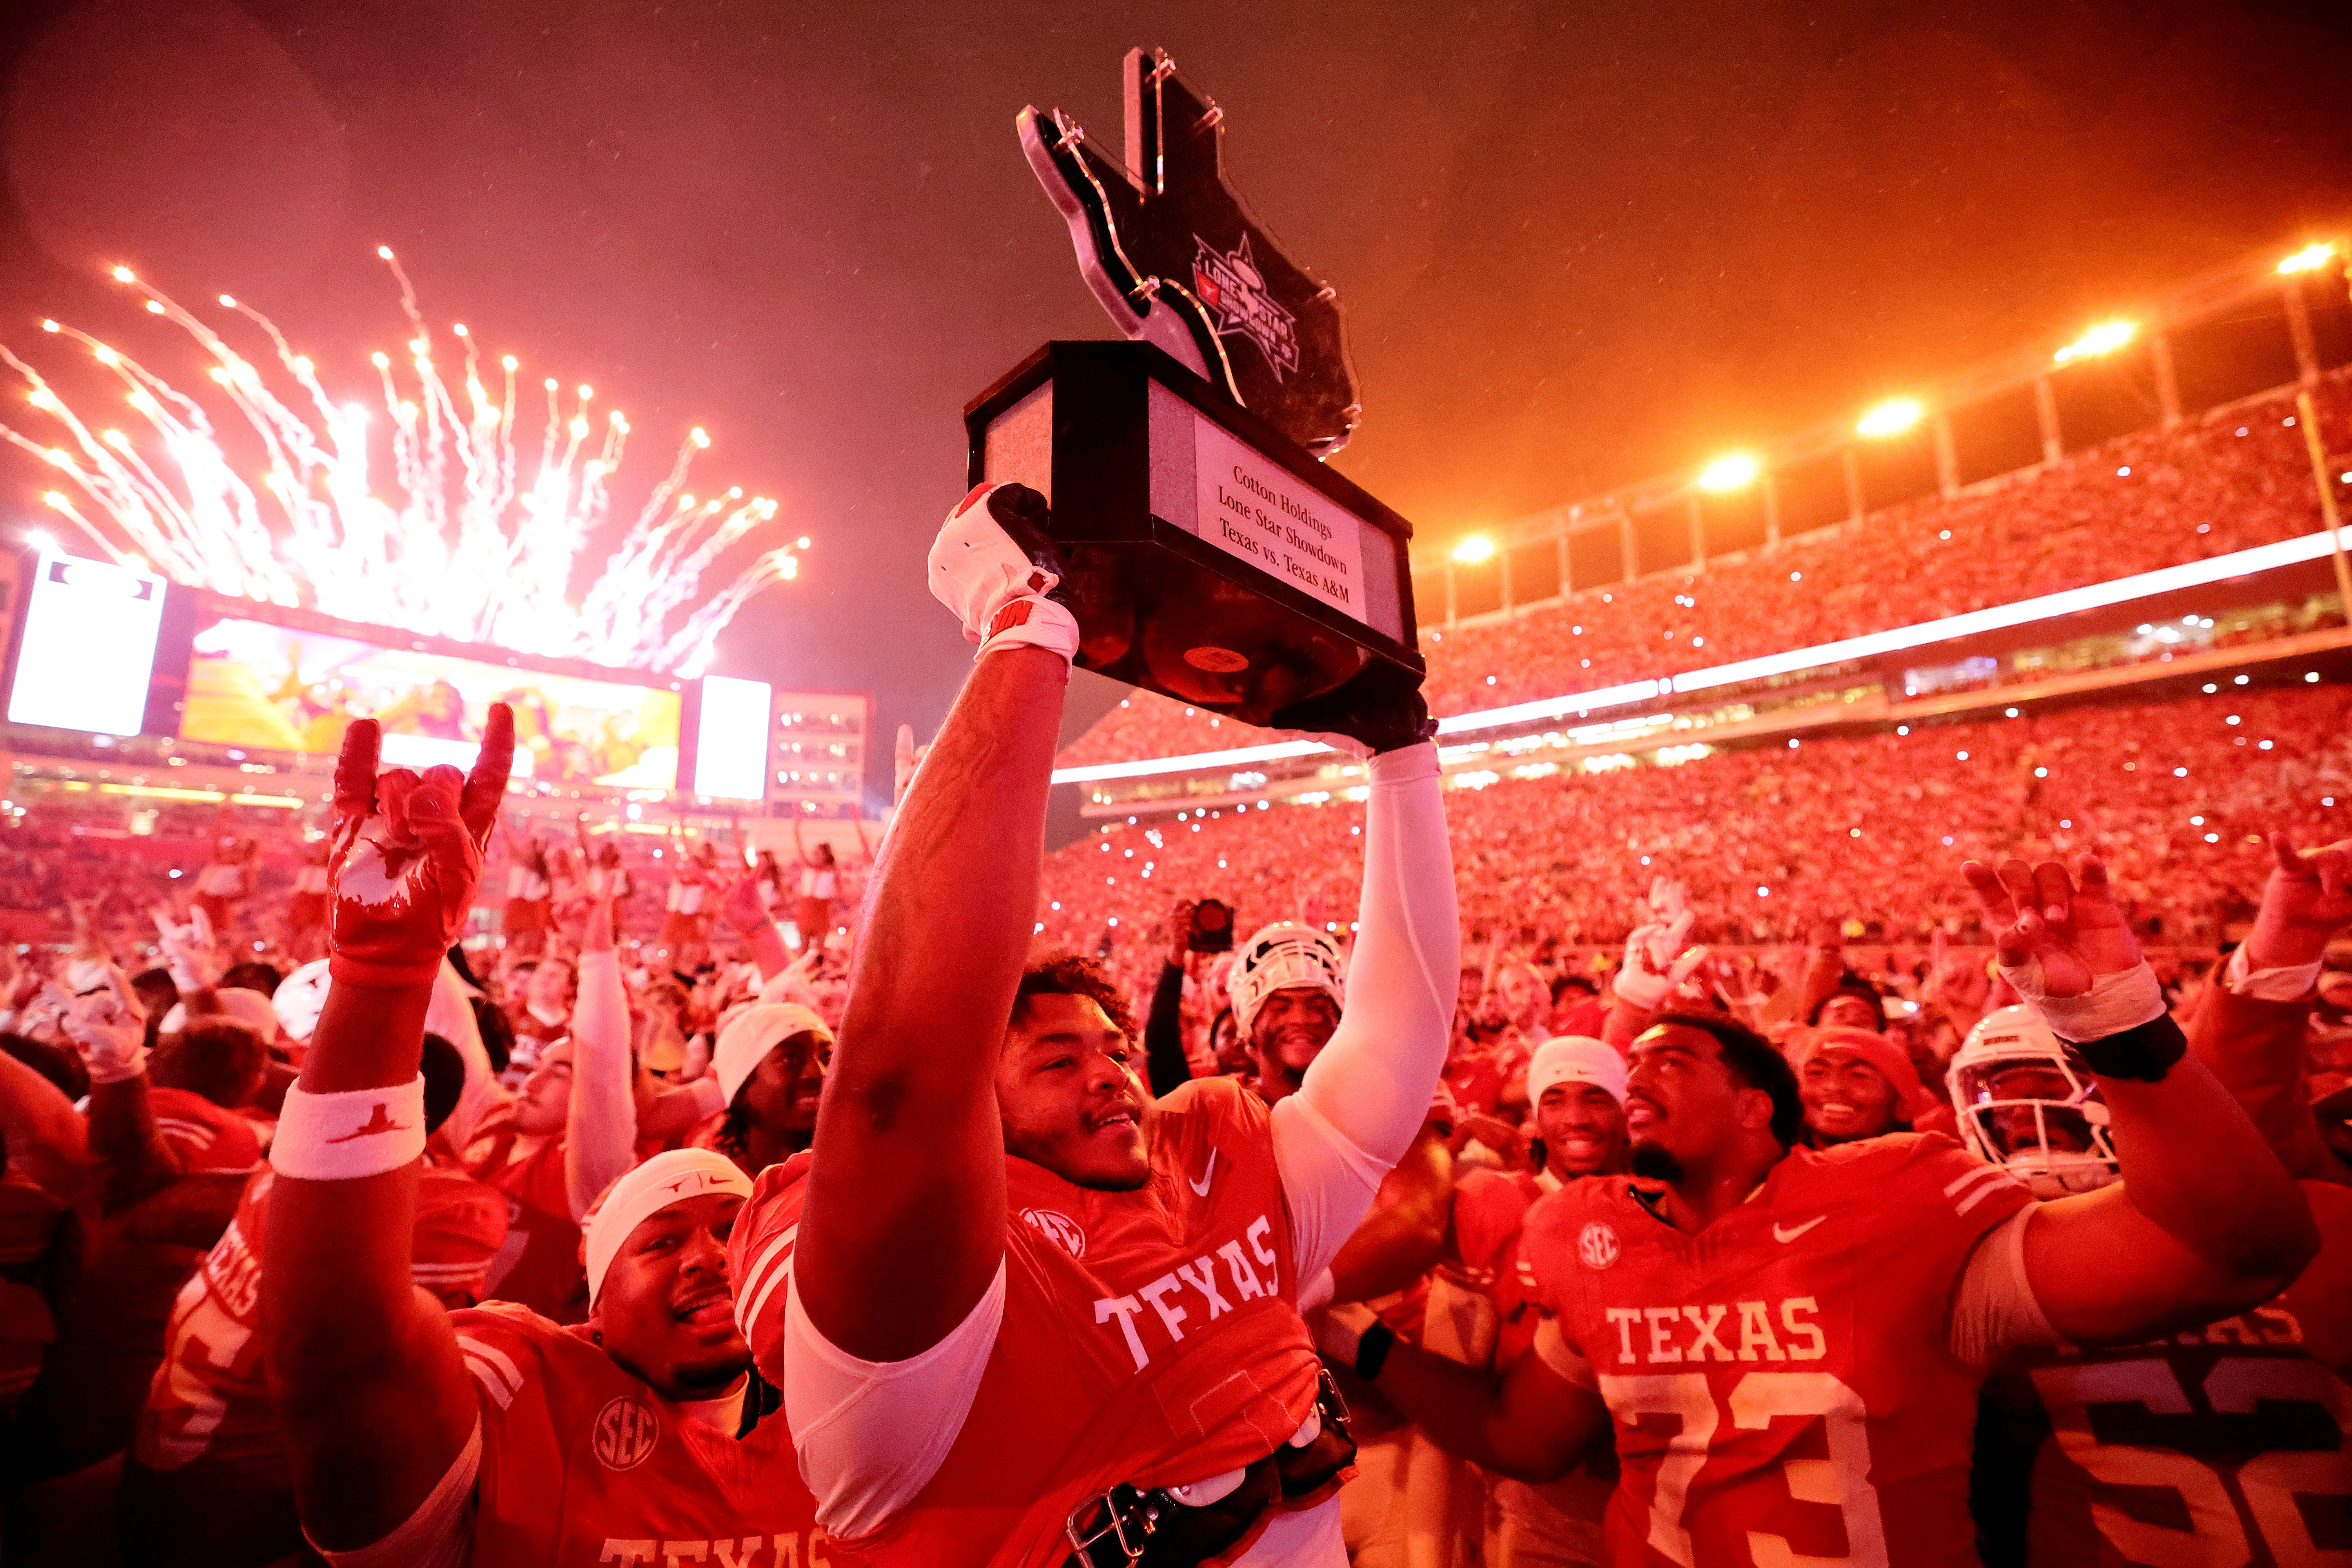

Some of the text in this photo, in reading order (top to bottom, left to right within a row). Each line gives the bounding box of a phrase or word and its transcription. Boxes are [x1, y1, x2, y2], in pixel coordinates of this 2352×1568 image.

[1205, 259, 1238, 299] LONE
[1219, 485, 1347, 575] Lone Star Showdown
[1234, 466, 1332, 540] Cotton Holdings
[1220, 517, 1349, 603] Texas vs. Texas A&M
[1581, 1227, 1617, 1266] SEC
[1094, 1215, 1279, 1374] TEXAS
[1606, 1296, 1827, 1364] TEXAS
[599, 1401, 655, 1465] SEC
[1598, 1372, 1889, 1568] 73
